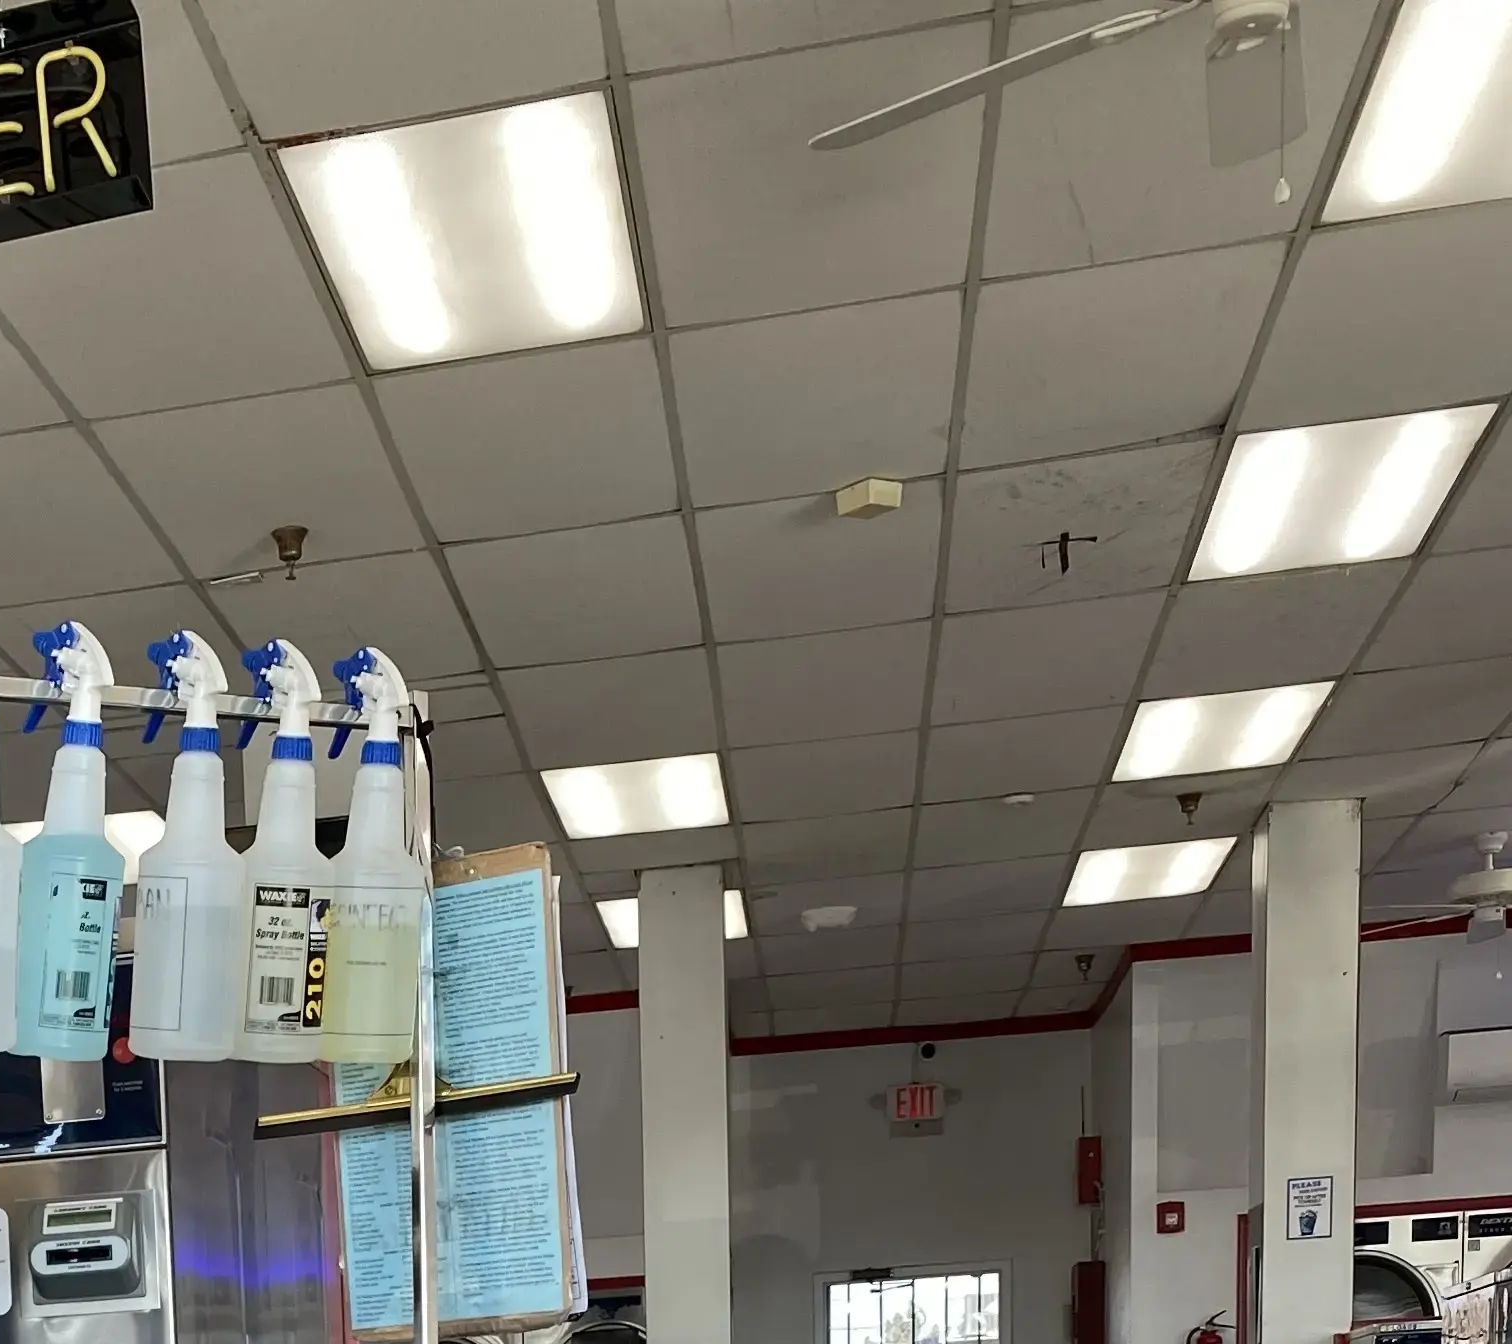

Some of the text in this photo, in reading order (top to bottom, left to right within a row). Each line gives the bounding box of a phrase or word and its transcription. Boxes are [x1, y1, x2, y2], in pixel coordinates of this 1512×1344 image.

[268, 916, 279, 926] 32
[255, 929, 279, 940] Spray
[305, 957, 324, 1020] 210
[896, 1086, 937, 1119] EXIT
